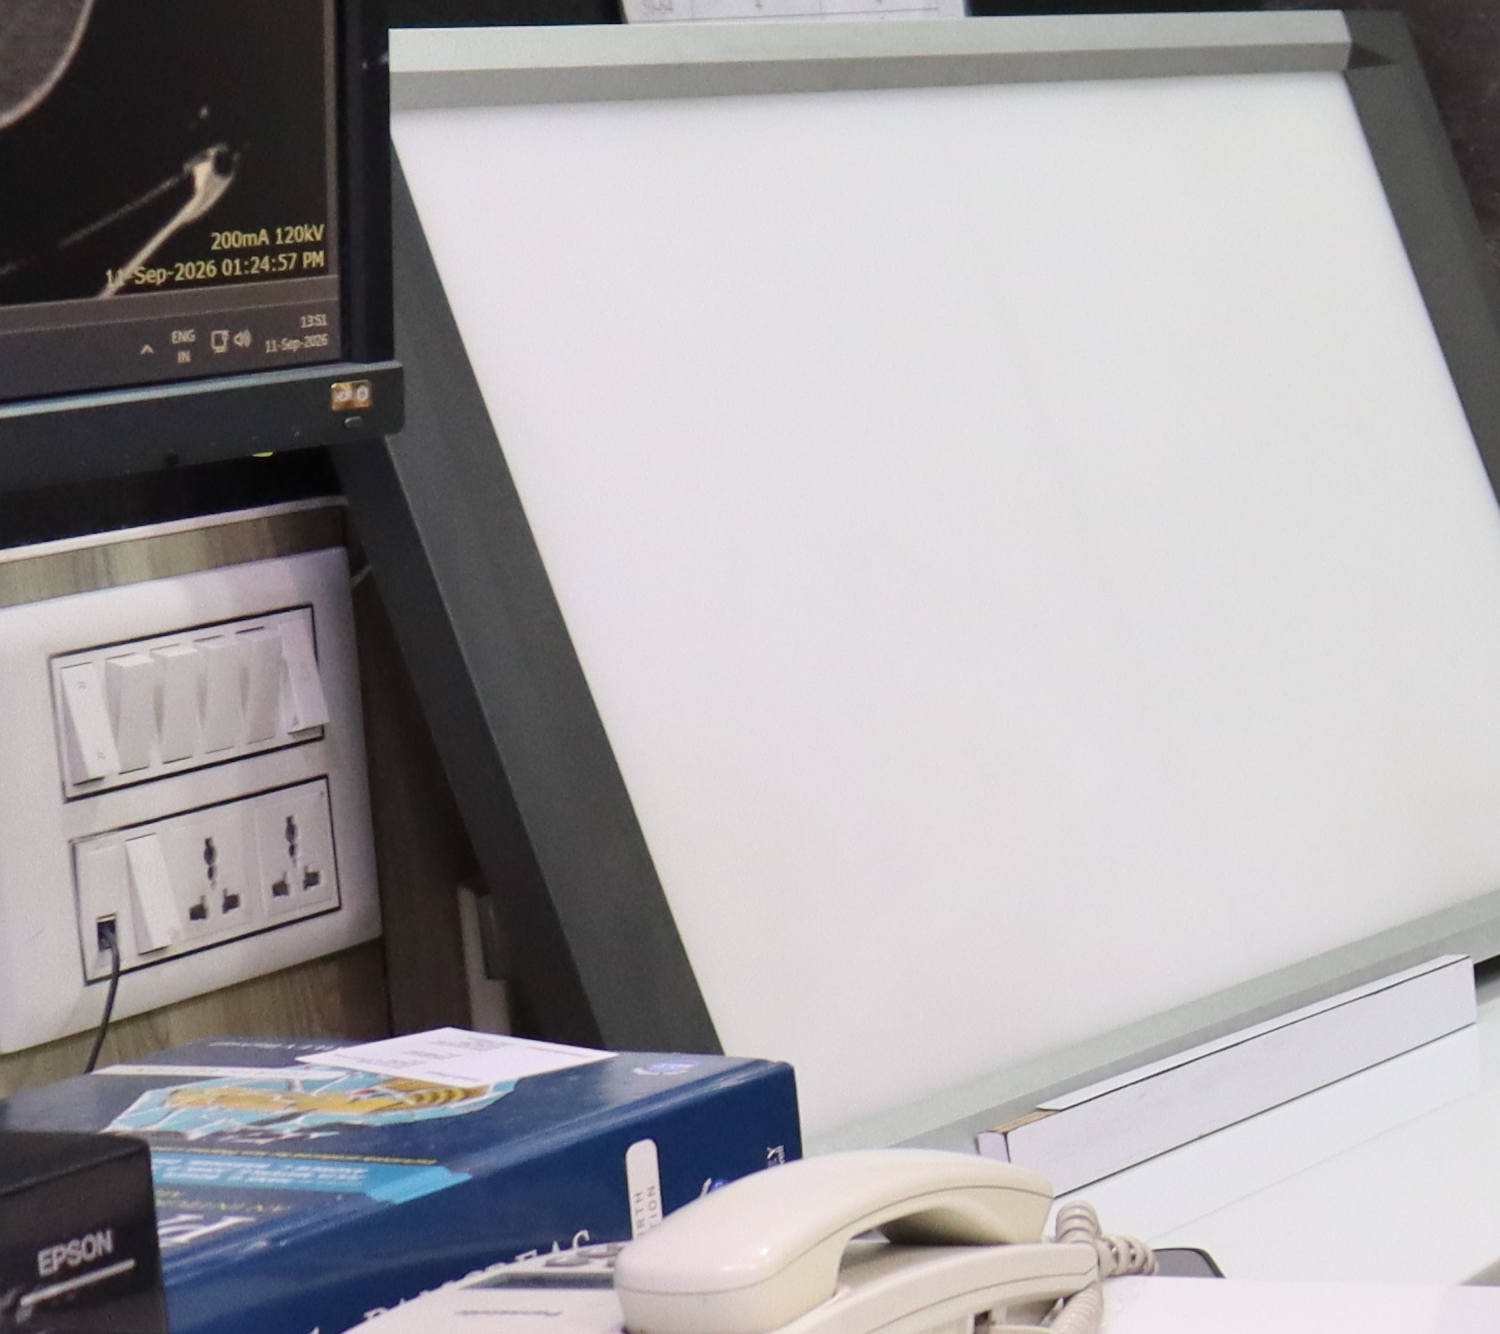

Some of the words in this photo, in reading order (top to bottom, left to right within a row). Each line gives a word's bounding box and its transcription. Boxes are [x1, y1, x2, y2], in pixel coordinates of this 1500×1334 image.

[211, 230, 269, 250] 200mA
[275, 224, 324, 245] 120kV
[222, 253, 297, 276] 01:24:57
[303, 251, 324, 268] PM
[171, 329, 196, 344] ENG
[265, 334, 328, 354] 11-Sep-2026
[38, 1229, 113, 1277] EPSON
